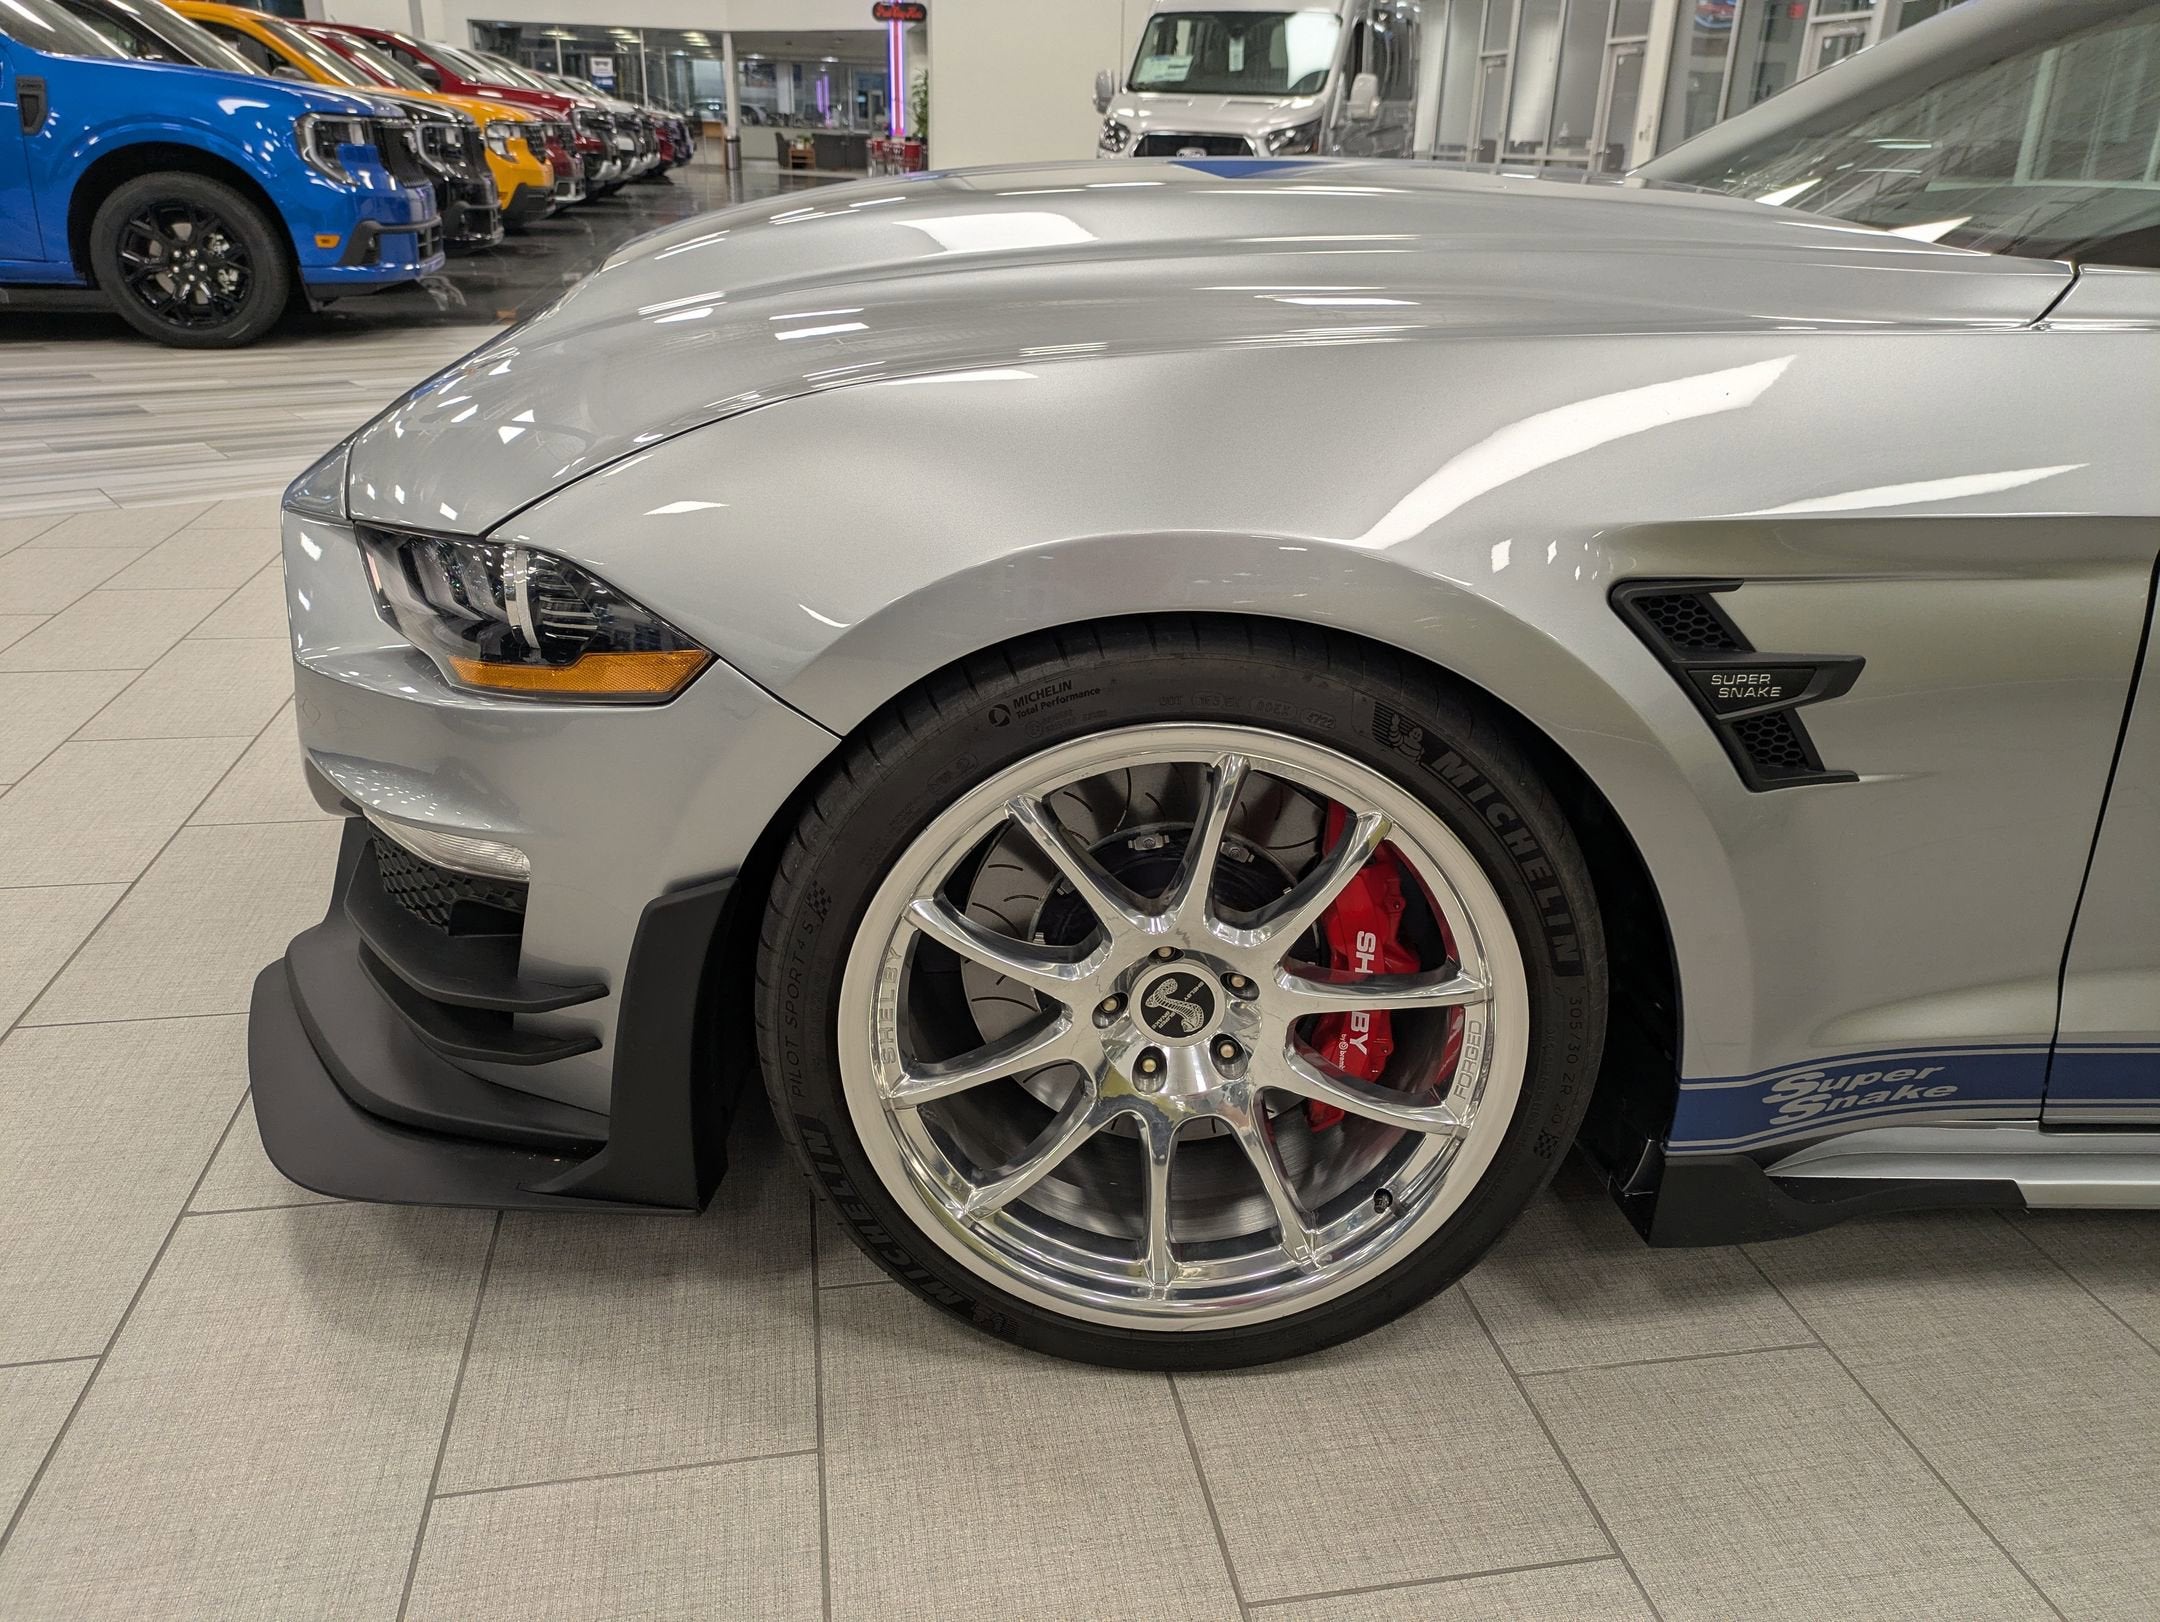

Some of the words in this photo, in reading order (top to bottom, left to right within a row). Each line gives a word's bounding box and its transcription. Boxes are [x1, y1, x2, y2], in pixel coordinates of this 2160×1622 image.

[1012, 679, 1072, 709] MICHELIN
[1711, 673, 1771, 685] SUPER
[1718, 686, 1782, 698] SNAKE
[1016, 703, 1038, 719] Total
[1040, 687, 1101, 711] Performance
[1430, 749, 1580, 965] MICHELIN
[797, 940, 807, 950] 4
[802, 921, 815, 938] S
[784, 957, 807, 1031] SPORT
[880, 946, 903, 1066] SHELBY
[1349, 931, 1377, 1055] SHBY
[1567, 996, 1583, 1065] 305/30
[783, 1040, 804, 1098] PILOT
[1453, 1020, 1482, 1100] FORGED
[1560, 1072, 1575, 1096] ZR
[1762, 1066, 1946, 1104] Super
[1551, 1104, 1566, 1125] 20
[1768, 1083, 1958, 1126] Snake
[800, 1128, 964, 1305] MICHELIN
